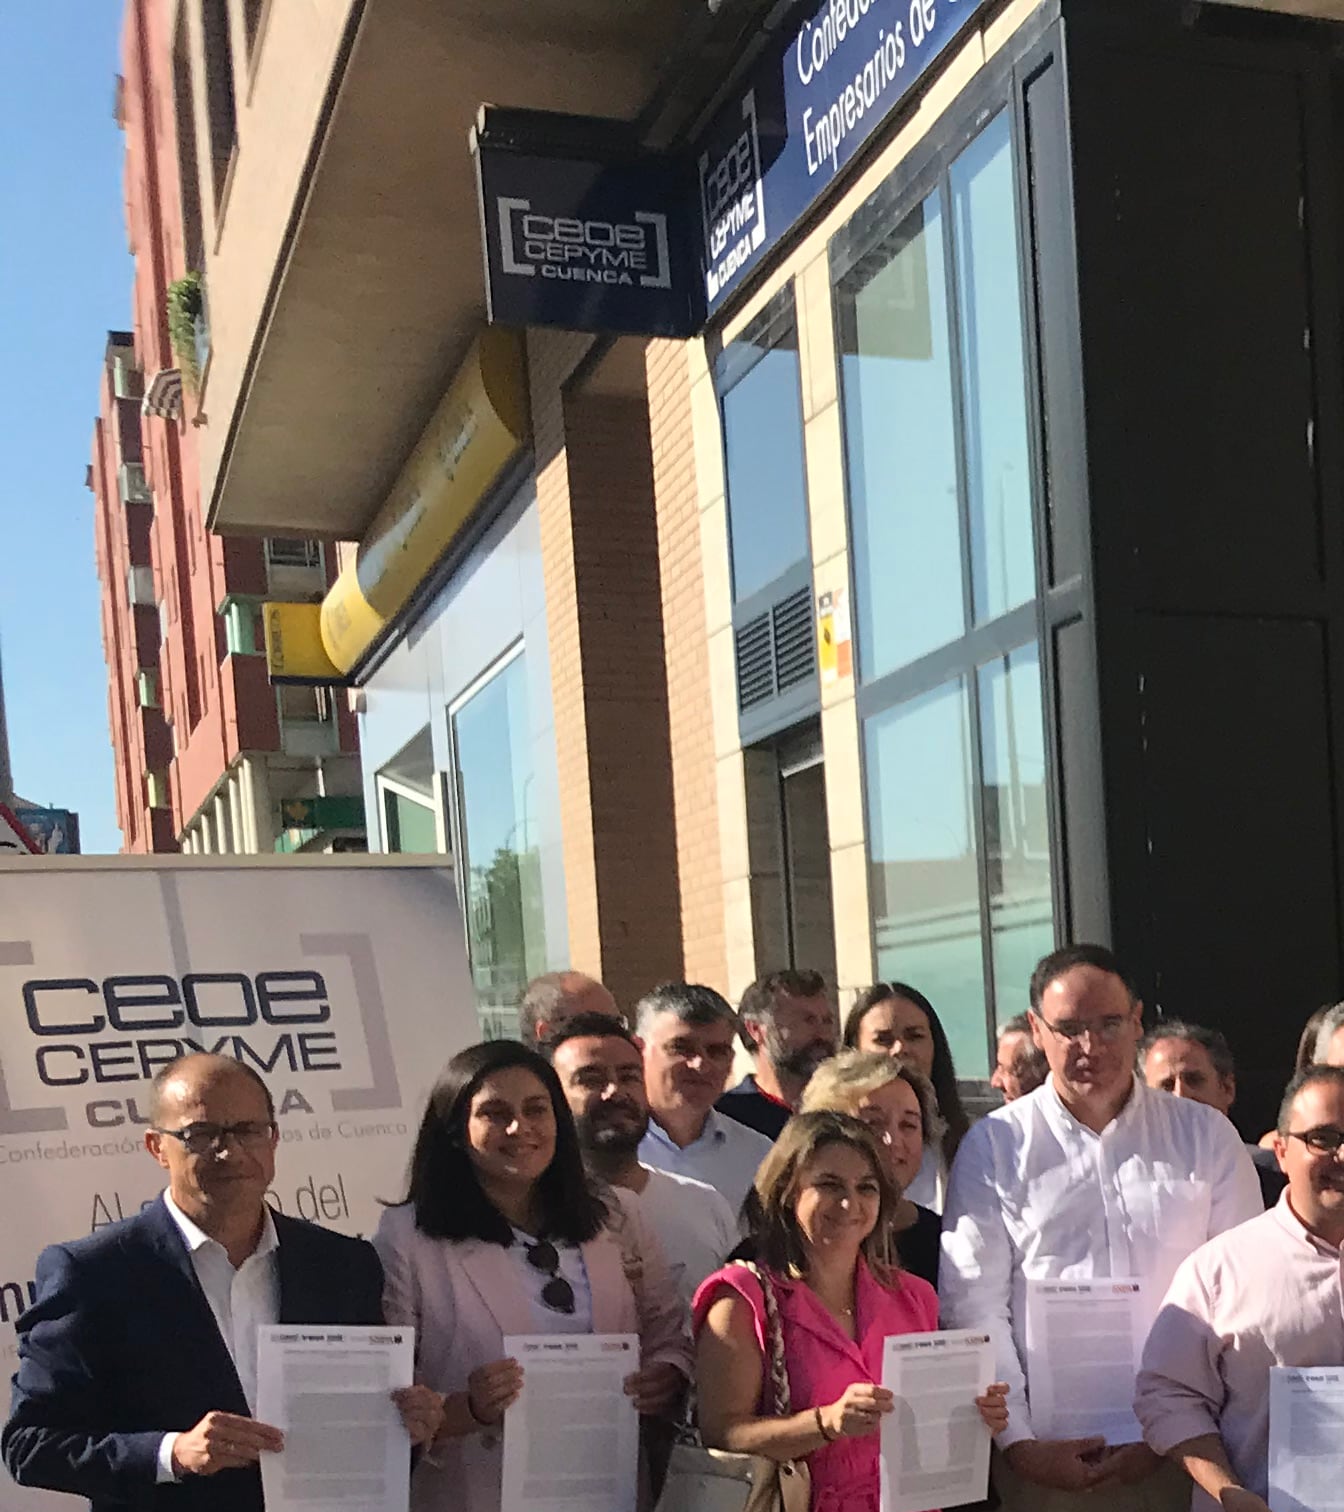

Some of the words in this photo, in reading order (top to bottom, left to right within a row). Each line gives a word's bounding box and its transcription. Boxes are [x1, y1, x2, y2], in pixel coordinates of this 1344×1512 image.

[802, 21, 905, 176] Empresarios
[710, 181, 755, 260] CEPYME
[524, 240, 648, 270] CEPYME
[541, 264, 633, 285] CUENCA
[718, 232, 752, 288] CUENCA
[35, 1031, 342, 1087] CEPYME
[308, 1122, 333, 1140] de
[337, 1120, 408, 1139] Cuenca
[296, 1173, 350, 1221] del
